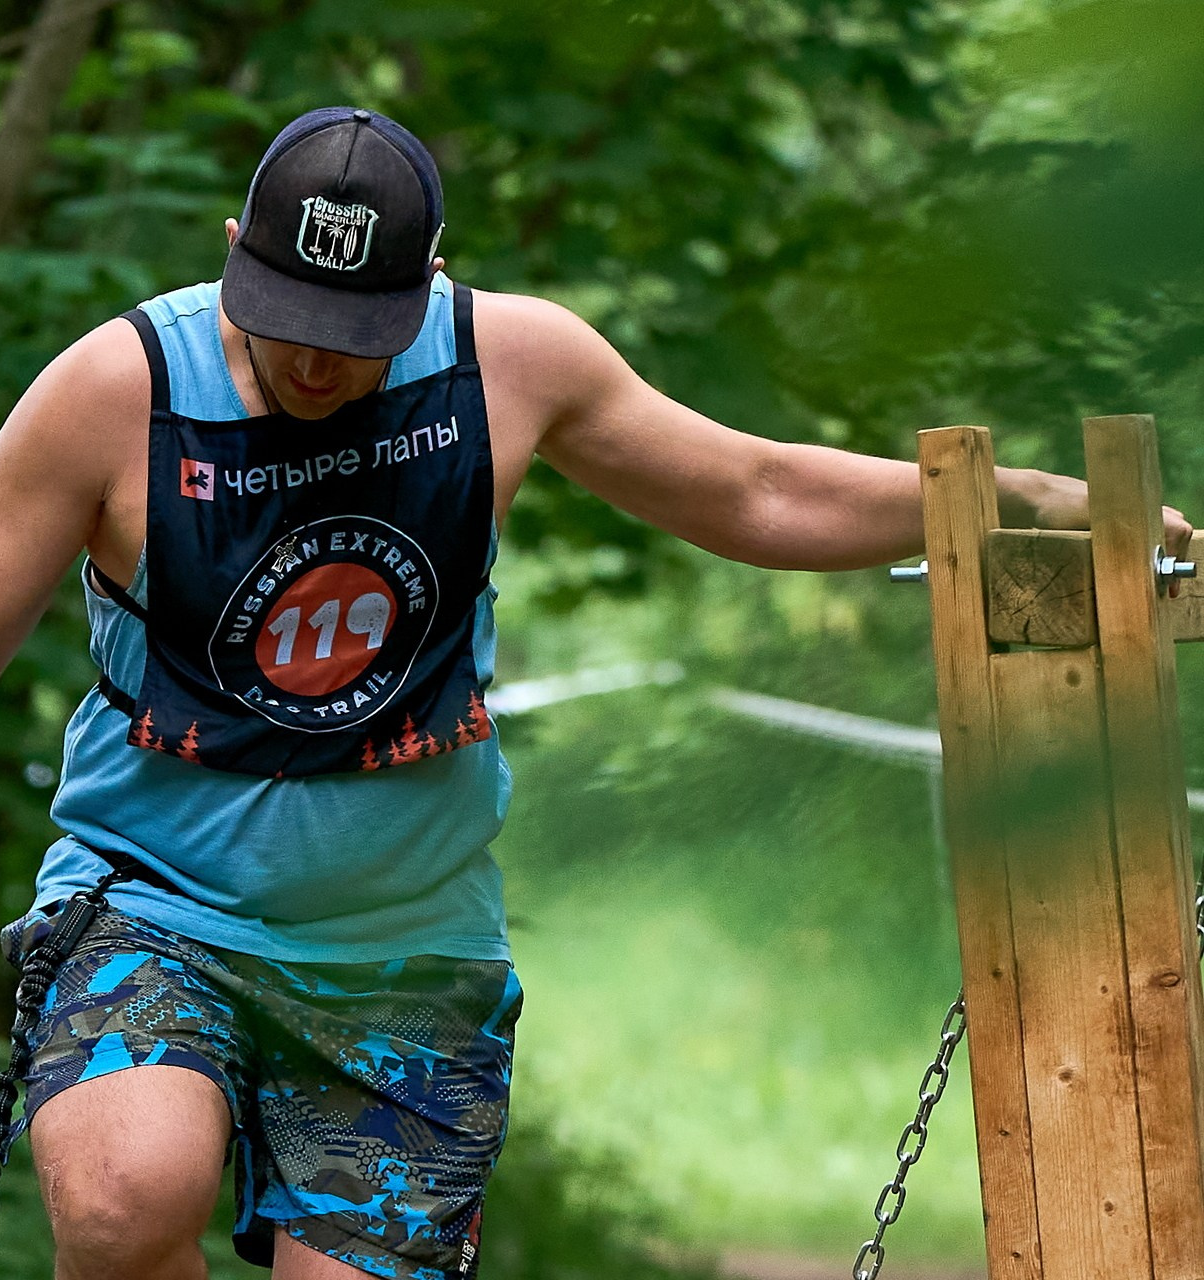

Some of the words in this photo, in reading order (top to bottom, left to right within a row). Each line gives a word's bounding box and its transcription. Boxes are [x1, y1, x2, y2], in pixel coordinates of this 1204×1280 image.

[316, 254, 344, 271] BALI
[224, 448, 361, 496] четыре
[372, 415, 459, 469] лапы
[226, 538, 319, 643] RUSSAN
[330, 531, 426, 614] EXTREME
[267, 592, 391, 666] 119
[313, 670, 393, 718] TRAIL
